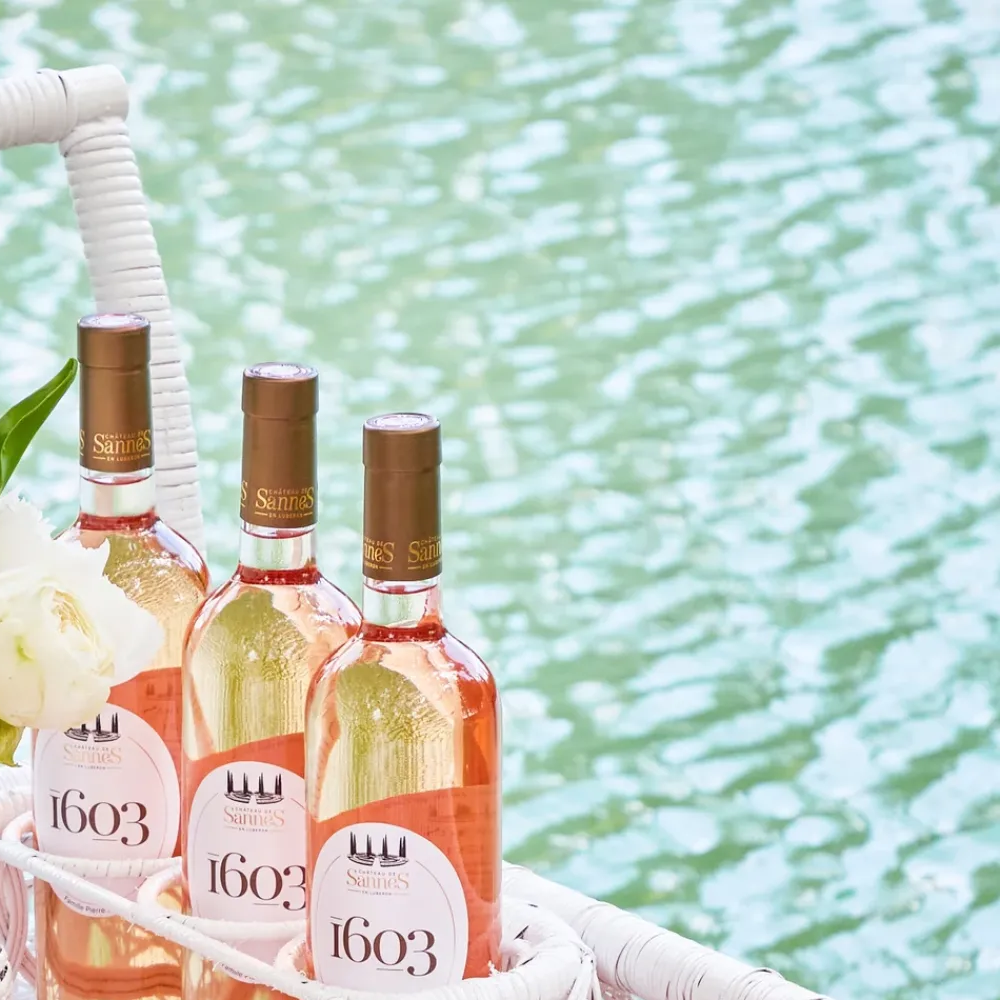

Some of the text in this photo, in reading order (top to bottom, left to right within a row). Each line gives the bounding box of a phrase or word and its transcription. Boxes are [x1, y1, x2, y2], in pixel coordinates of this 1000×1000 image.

[49, 788, 150, 847] 1603
[207, 852, 306, 912] 1603
[330, 916, 438, 977] 1603
